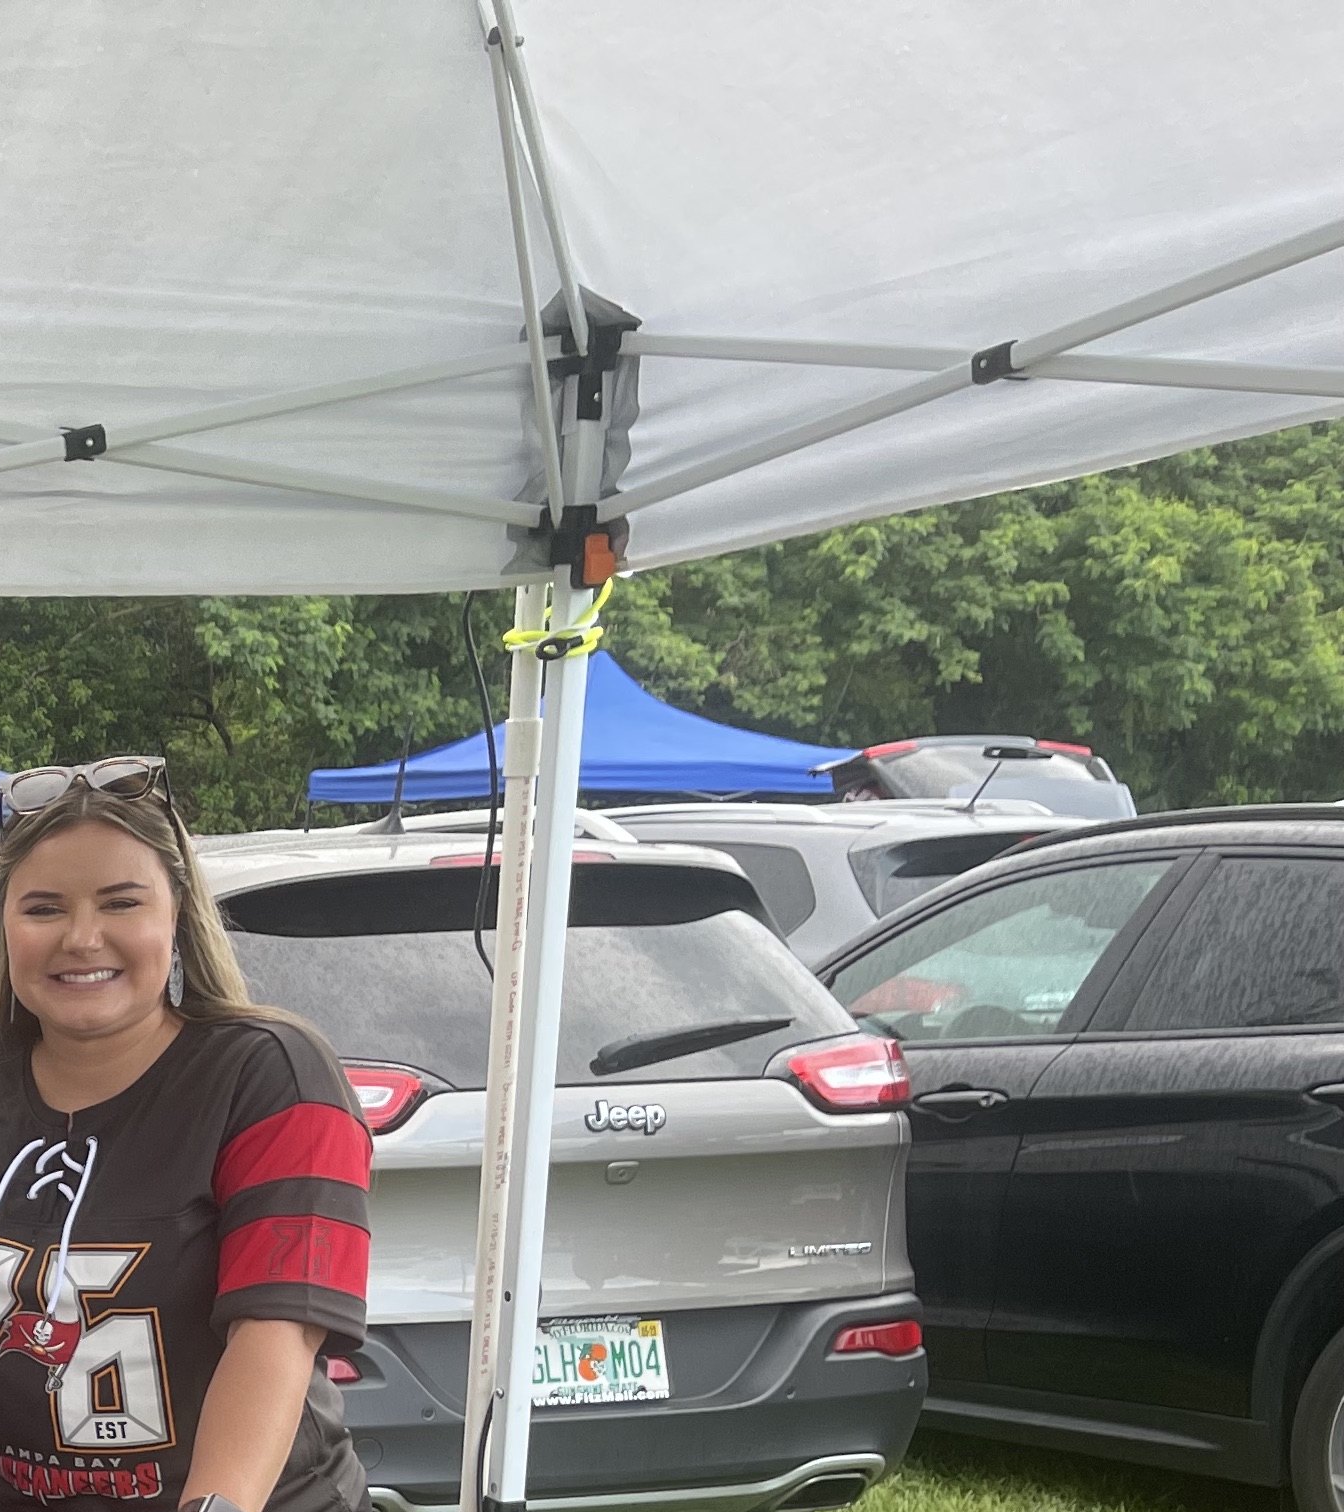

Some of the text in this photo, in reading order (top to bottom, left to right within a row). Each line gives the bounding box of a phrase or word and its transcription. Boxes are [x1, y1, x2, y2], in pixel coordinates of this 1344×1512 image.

[584, 1099, 667, 1135] Jeep
[788, 1240, 872, 1258] LIMITED
[95, 1420, 129, 1440] EST
[74, 1456, 122, 1469] BAY
